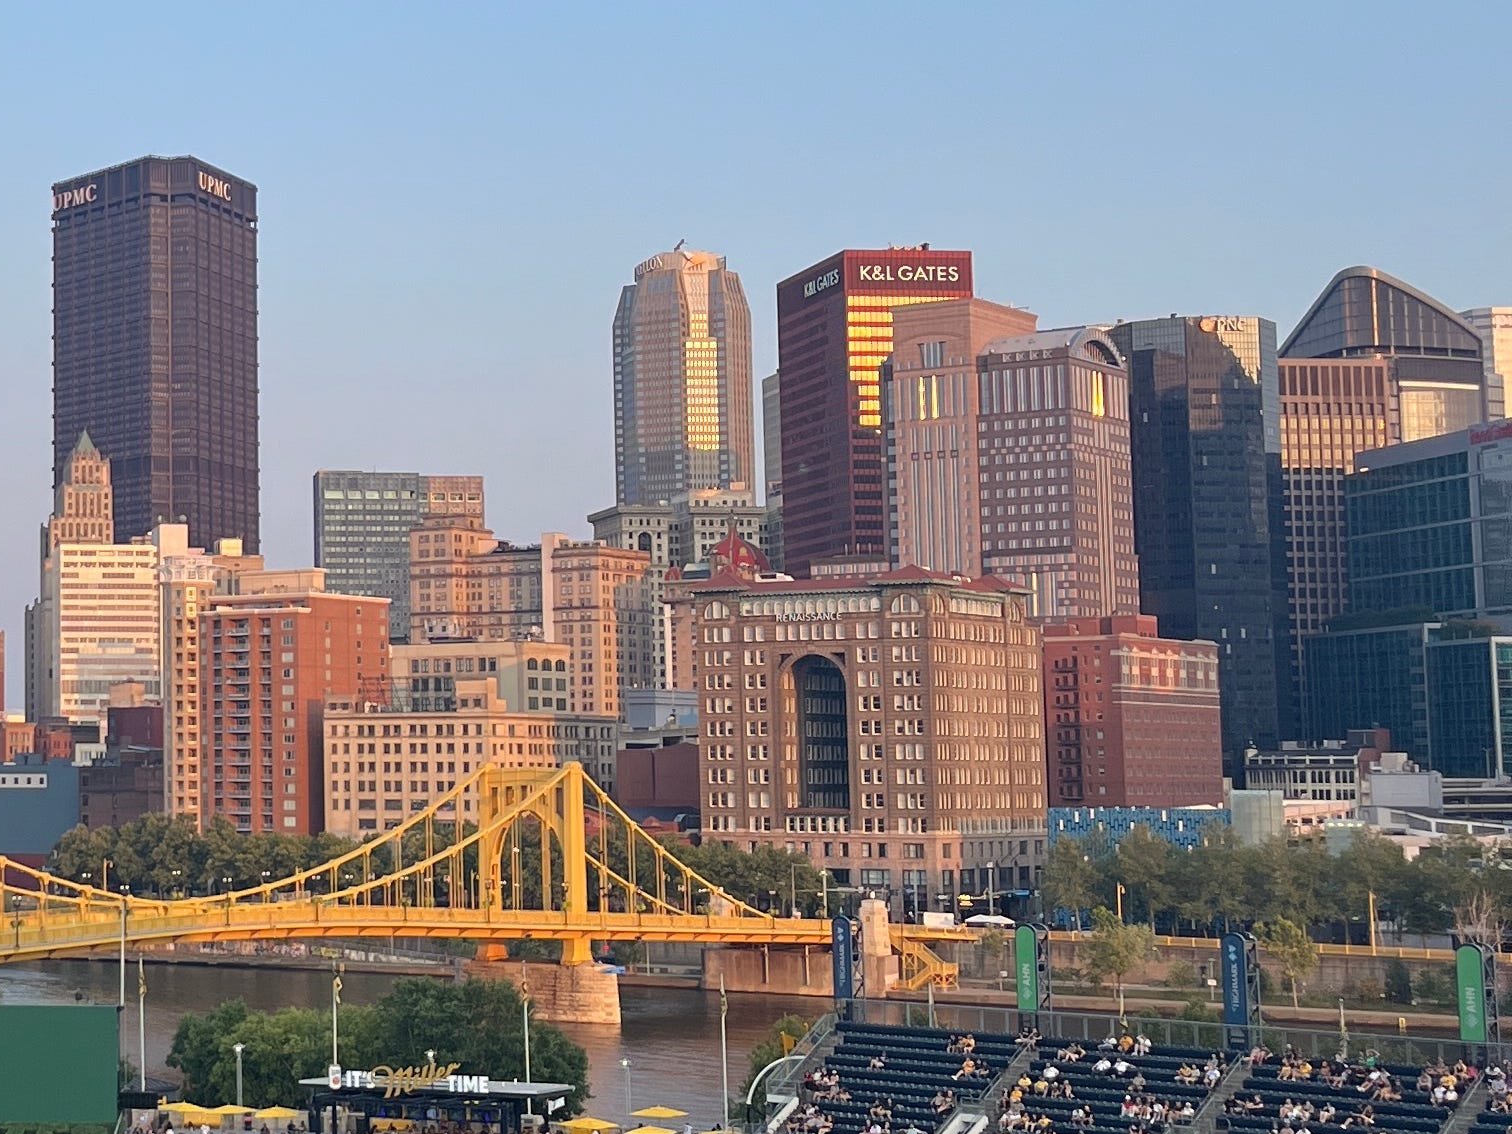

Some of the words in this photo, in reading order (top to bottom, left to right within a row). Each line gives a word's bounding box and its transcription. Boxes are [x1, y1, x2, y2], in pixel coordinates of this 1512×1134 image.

[52, 184, 97, 211] UPMC
[198, 171, 231, 201] UPMC
[816, 269, 839, 292] GATES
[859, 265, 895, 281] K&L
[897, 265, 959, 281] GATES
[775, 611, 842, 622] RENAISSANCE
[1021, 963, 1031, 987] AHN
[1464, 987, 1477, 1014] AHN
[372, 1062, 461, 1098] Miller
[447, 1075, 489, 1094] TIME
